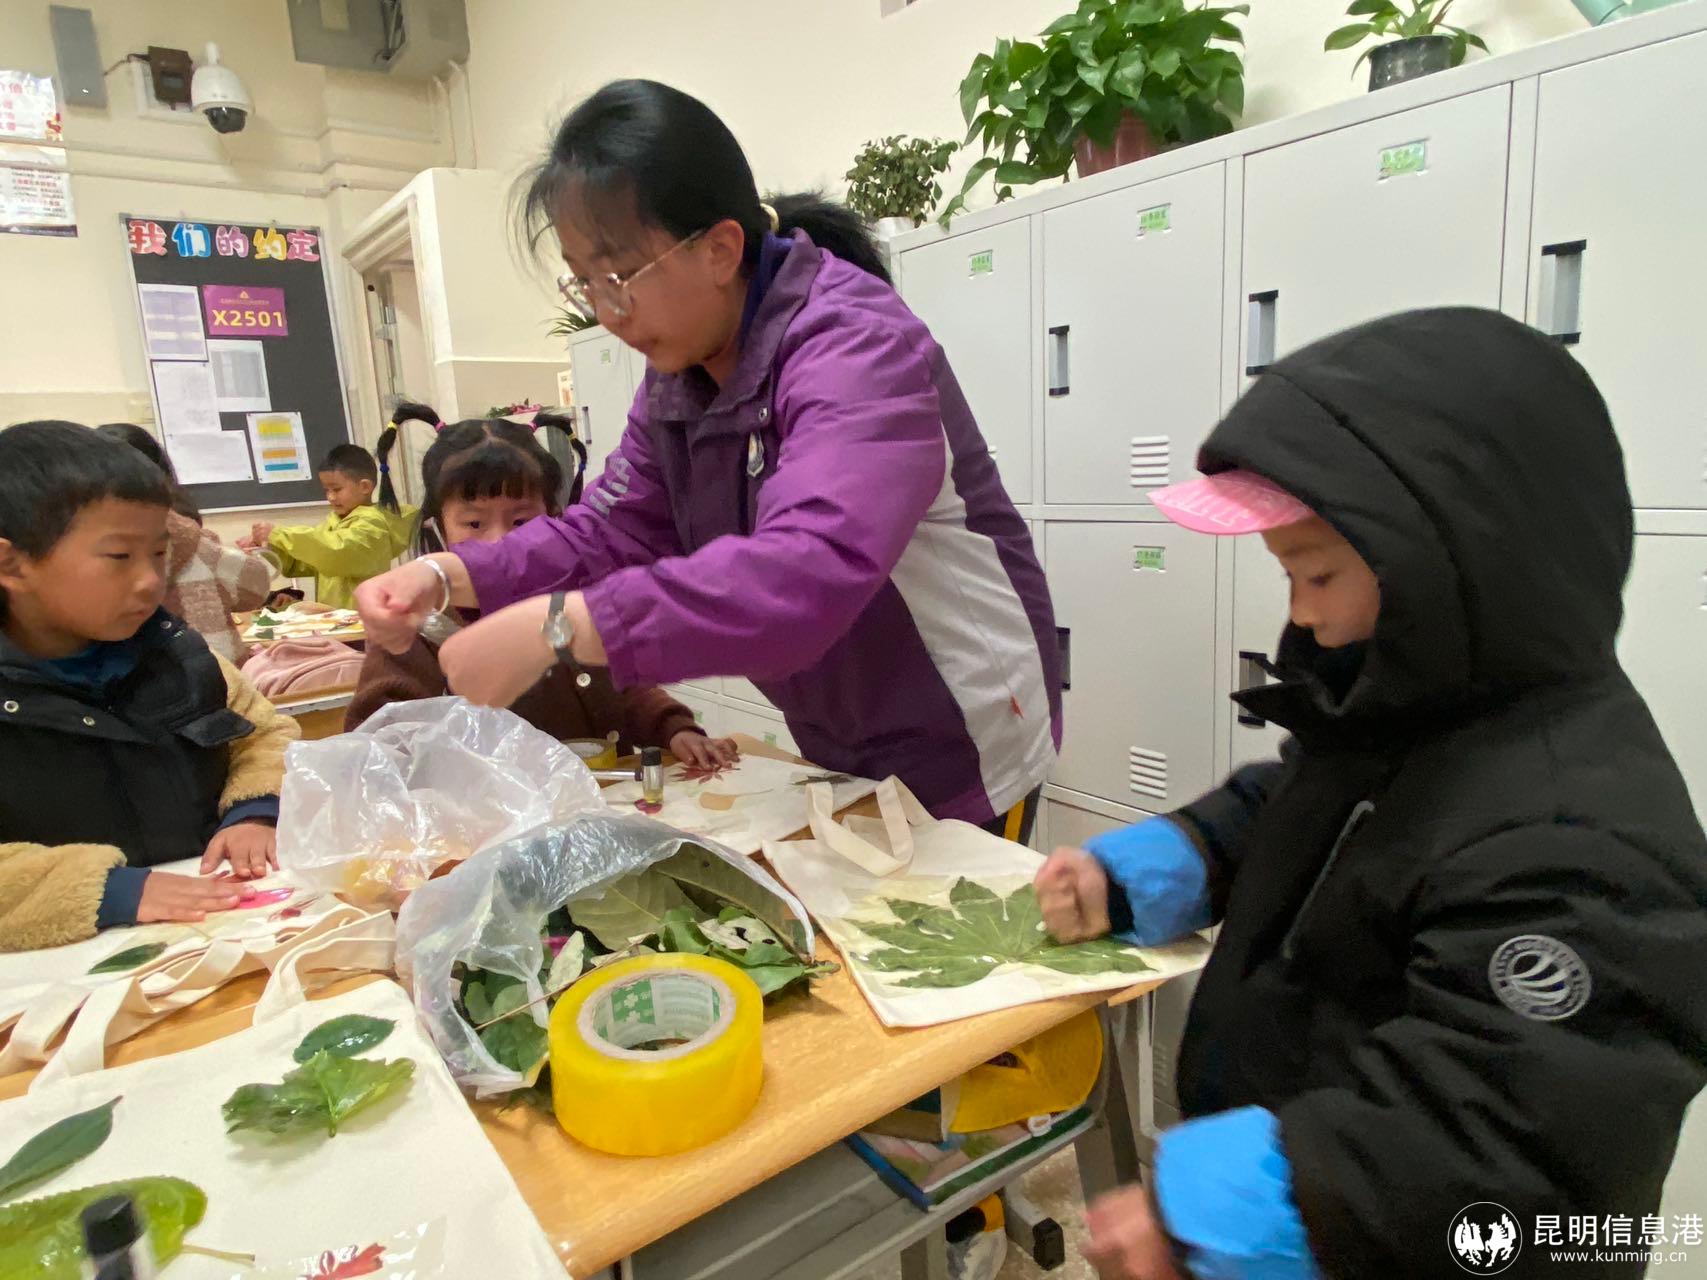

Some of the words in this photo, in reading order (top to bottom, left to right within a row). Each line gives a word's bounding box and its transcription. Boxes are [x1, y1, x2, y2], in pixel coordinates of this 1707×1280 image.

[128, 220, 321, 262] 我们的约定
[212, 309, 283, 328] X2501
